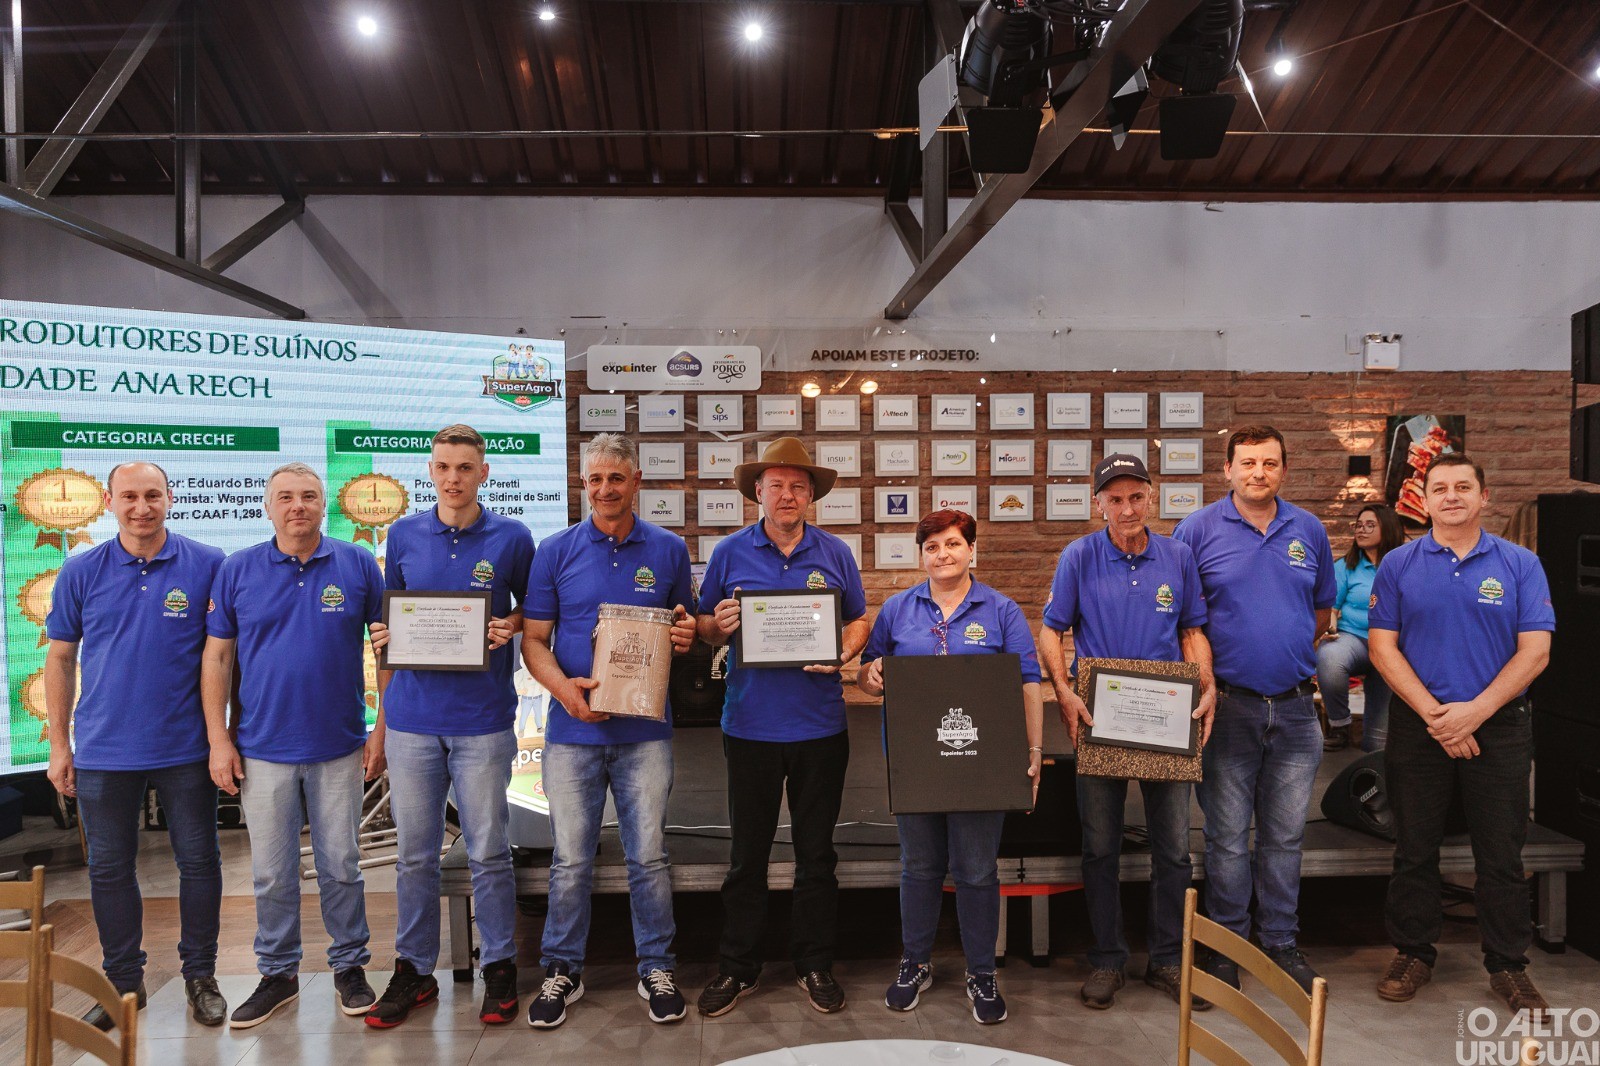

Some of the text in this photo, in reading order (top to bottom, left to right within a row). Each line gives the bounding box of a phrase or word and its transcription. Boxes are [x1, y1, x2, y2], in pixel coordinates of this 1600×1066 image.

[206, 331, 250, 355] DE
[254, 333, 357, 362] SUÍNOS
[811, 349, 979, 361] APOIAM ESTE PROJETO:
[713, 364, 746, 373] PORCO
[0, 364, 273, 398] DADE ANA RECH
[491, 381, 553, 394] SuperAgro
[61, 430, 236, 446] CATEGORIA CRECHE
[353, 435, 432, 449] CATEGORIA
[188, 477, 242, 488] Eduardo
[244, 477, 267, 488] Brit
[489, 479, 520, 488] Peretti
[217, 493, 264, 505] Wagner
[488, 492, 522, 502] Sidinei
[524, 492, 535, 501] de
[537, 492, 561, 502] Santi
[192, 509, 229, 520] CAAF
[232, 509, 263, 521] 1,298
